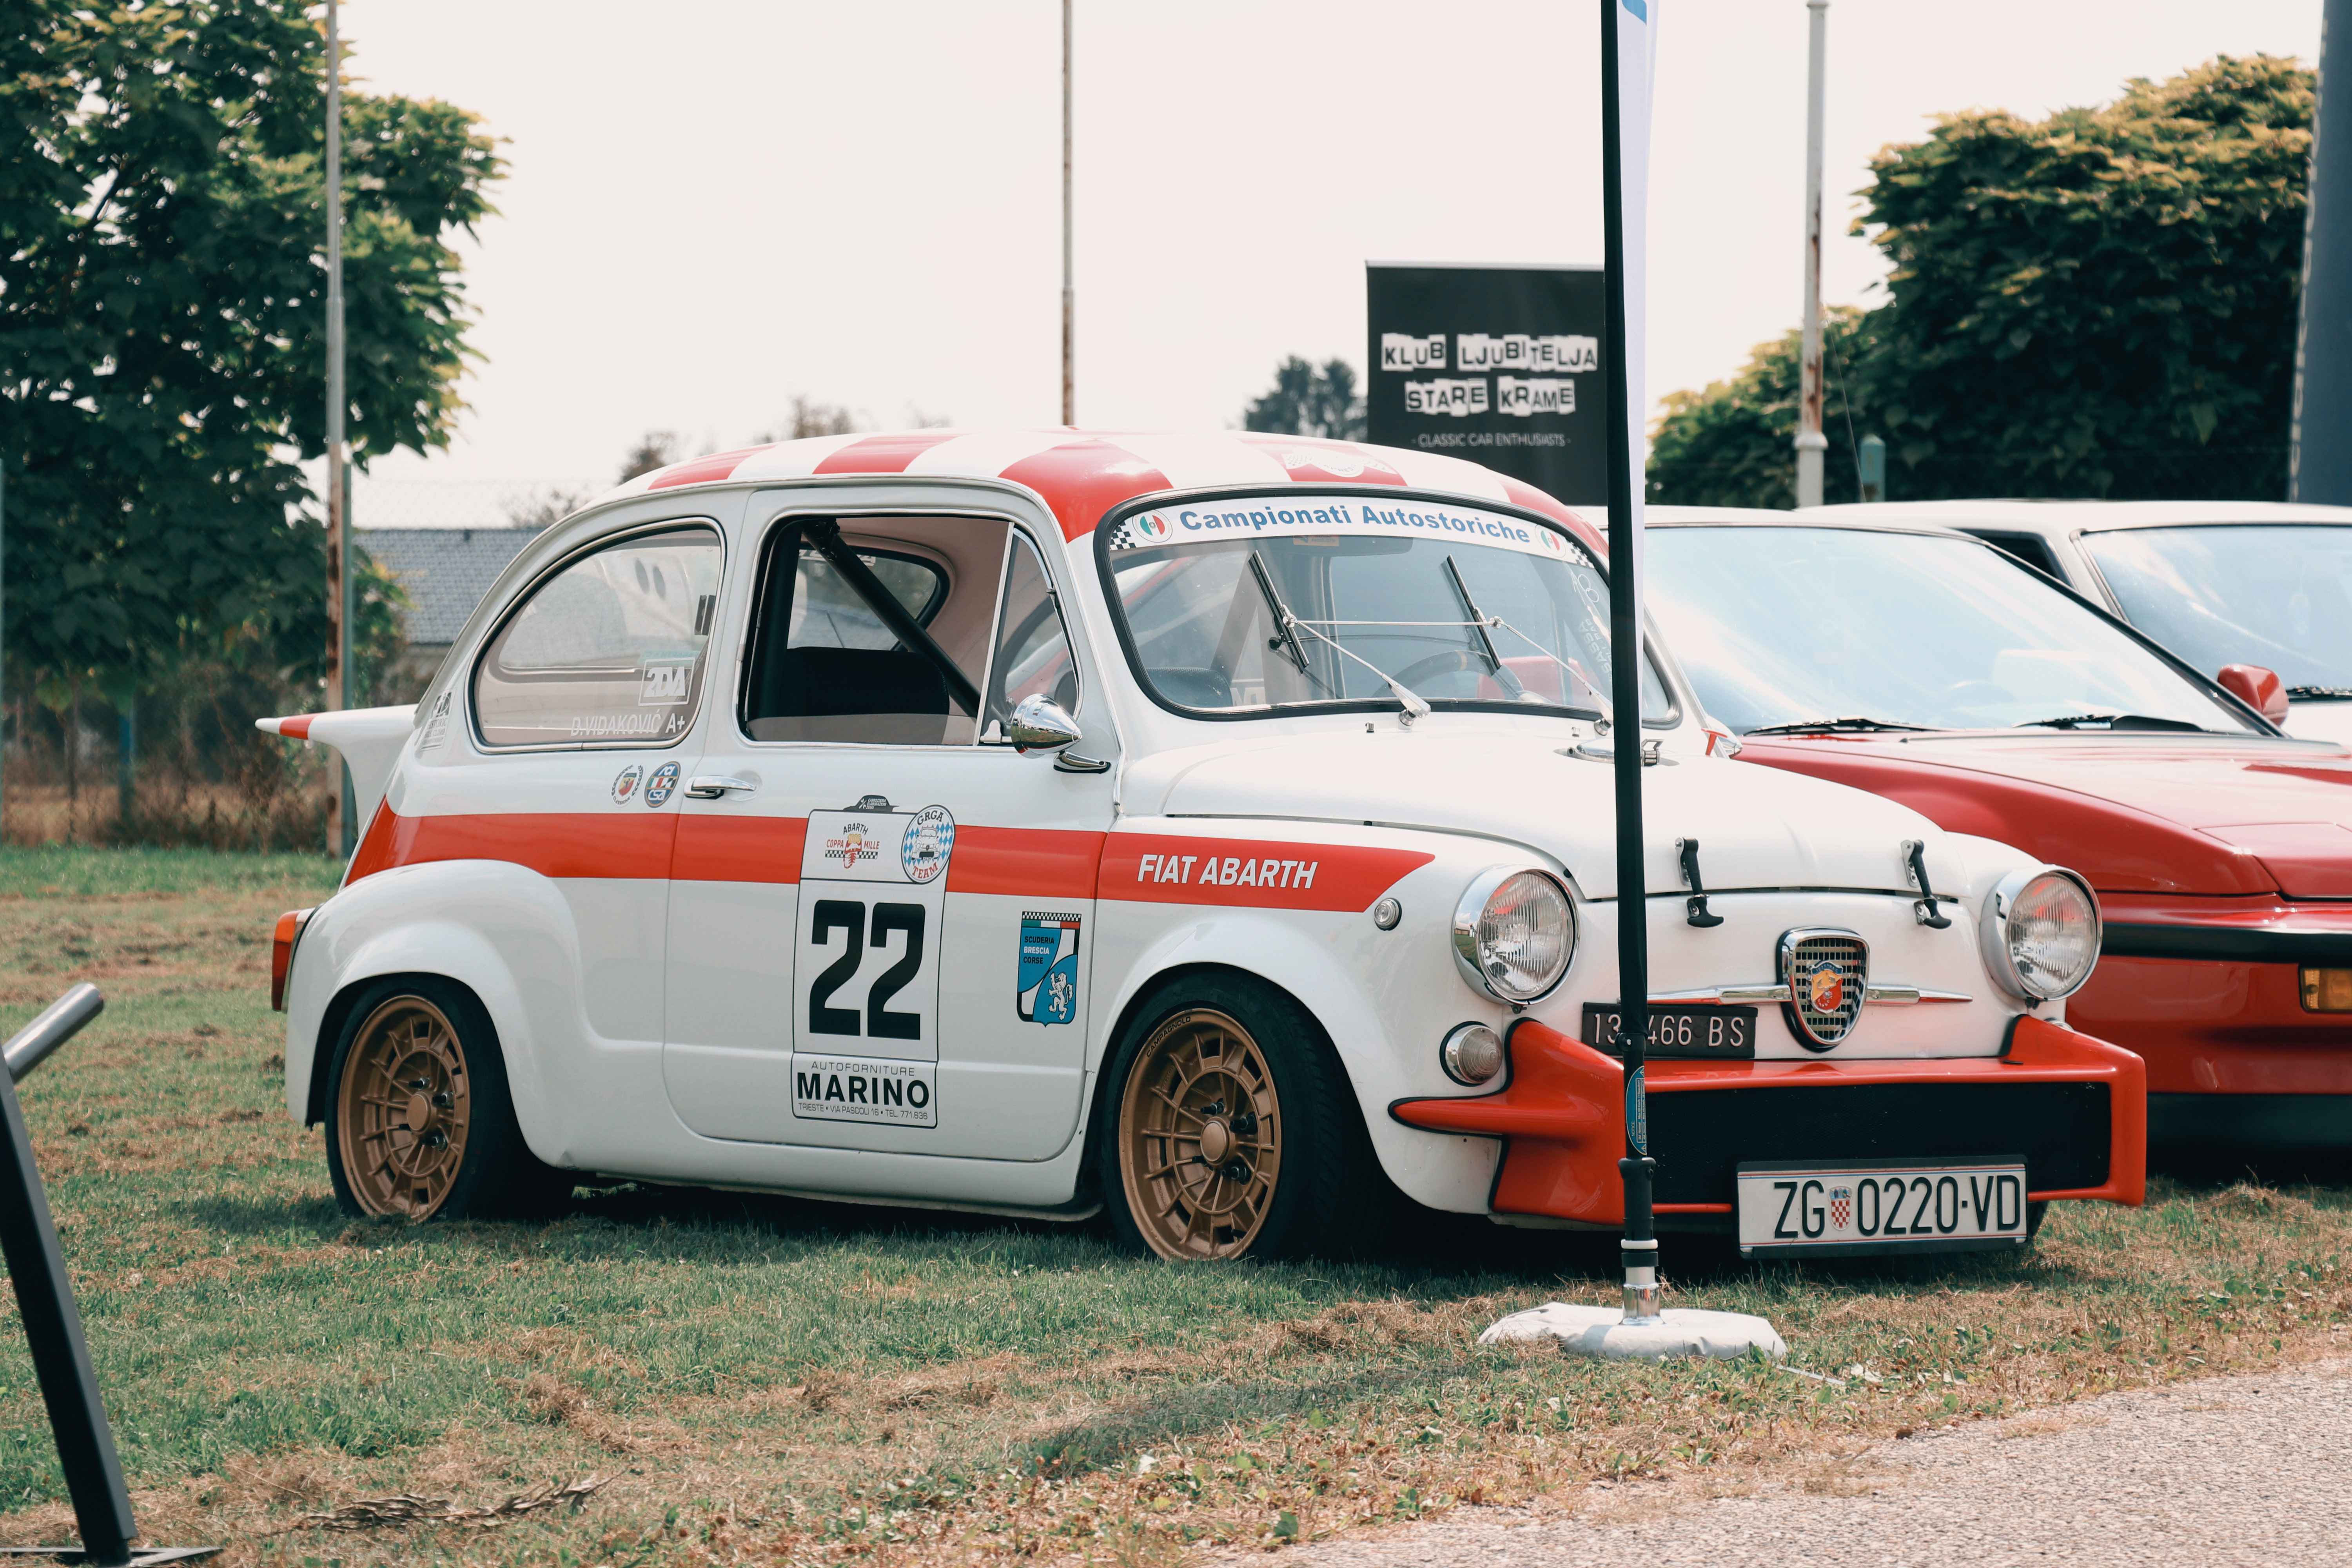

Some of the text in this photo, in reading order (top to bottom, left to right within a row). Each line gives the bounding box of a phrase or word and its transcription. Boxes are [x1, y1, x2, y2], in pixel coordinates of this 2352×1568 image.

[1383, 340, 1597, 367] KLUB LJUBITELJA
[1406, 386, 1575, 410] STARE KRAME
[1417, 433, 1566, 448] CLASSIC CAR ENTHUSIASTS
[1179, 504, 1531, 544] Campionati Autostoriche
[666, 713, 685, 733] A+
[917, 810, 944, 826] GRGA
[843, 823, 868, 835] ABARTH
[826, 839, 880, 849] COPPA MILLE
[912, 862, 938, 878] TEAM
[1137, 854, 1319, 889] FIAT ABARTH
[1024, 936, 1054, 944] SCUDERIA
[1024, 946, 1050, 955] BRESCIA
[1023, 956, 1044, 964] CORSE
[809, 899, 926, 1040] 22
[1146, 1016, 1191, 1058] CAMPAGNOLO
[1595, 1013, 1744, 1047] 13466 BS
[811, 1061, 915, 1076] AUTOFORNITURE
[797, 1072, 929, 1109] MARINO
[799, 1103, 824, 1112] TRIESTE
[842, 1106, 869, 1116] PASCOLI
[871, 1108, 879, 1116] 16
[885, 1109, 898, 1118] TEL.
[900, 1110, 928, 1120] 771.636
[1773, 1179, 1826, 1240] ZG
